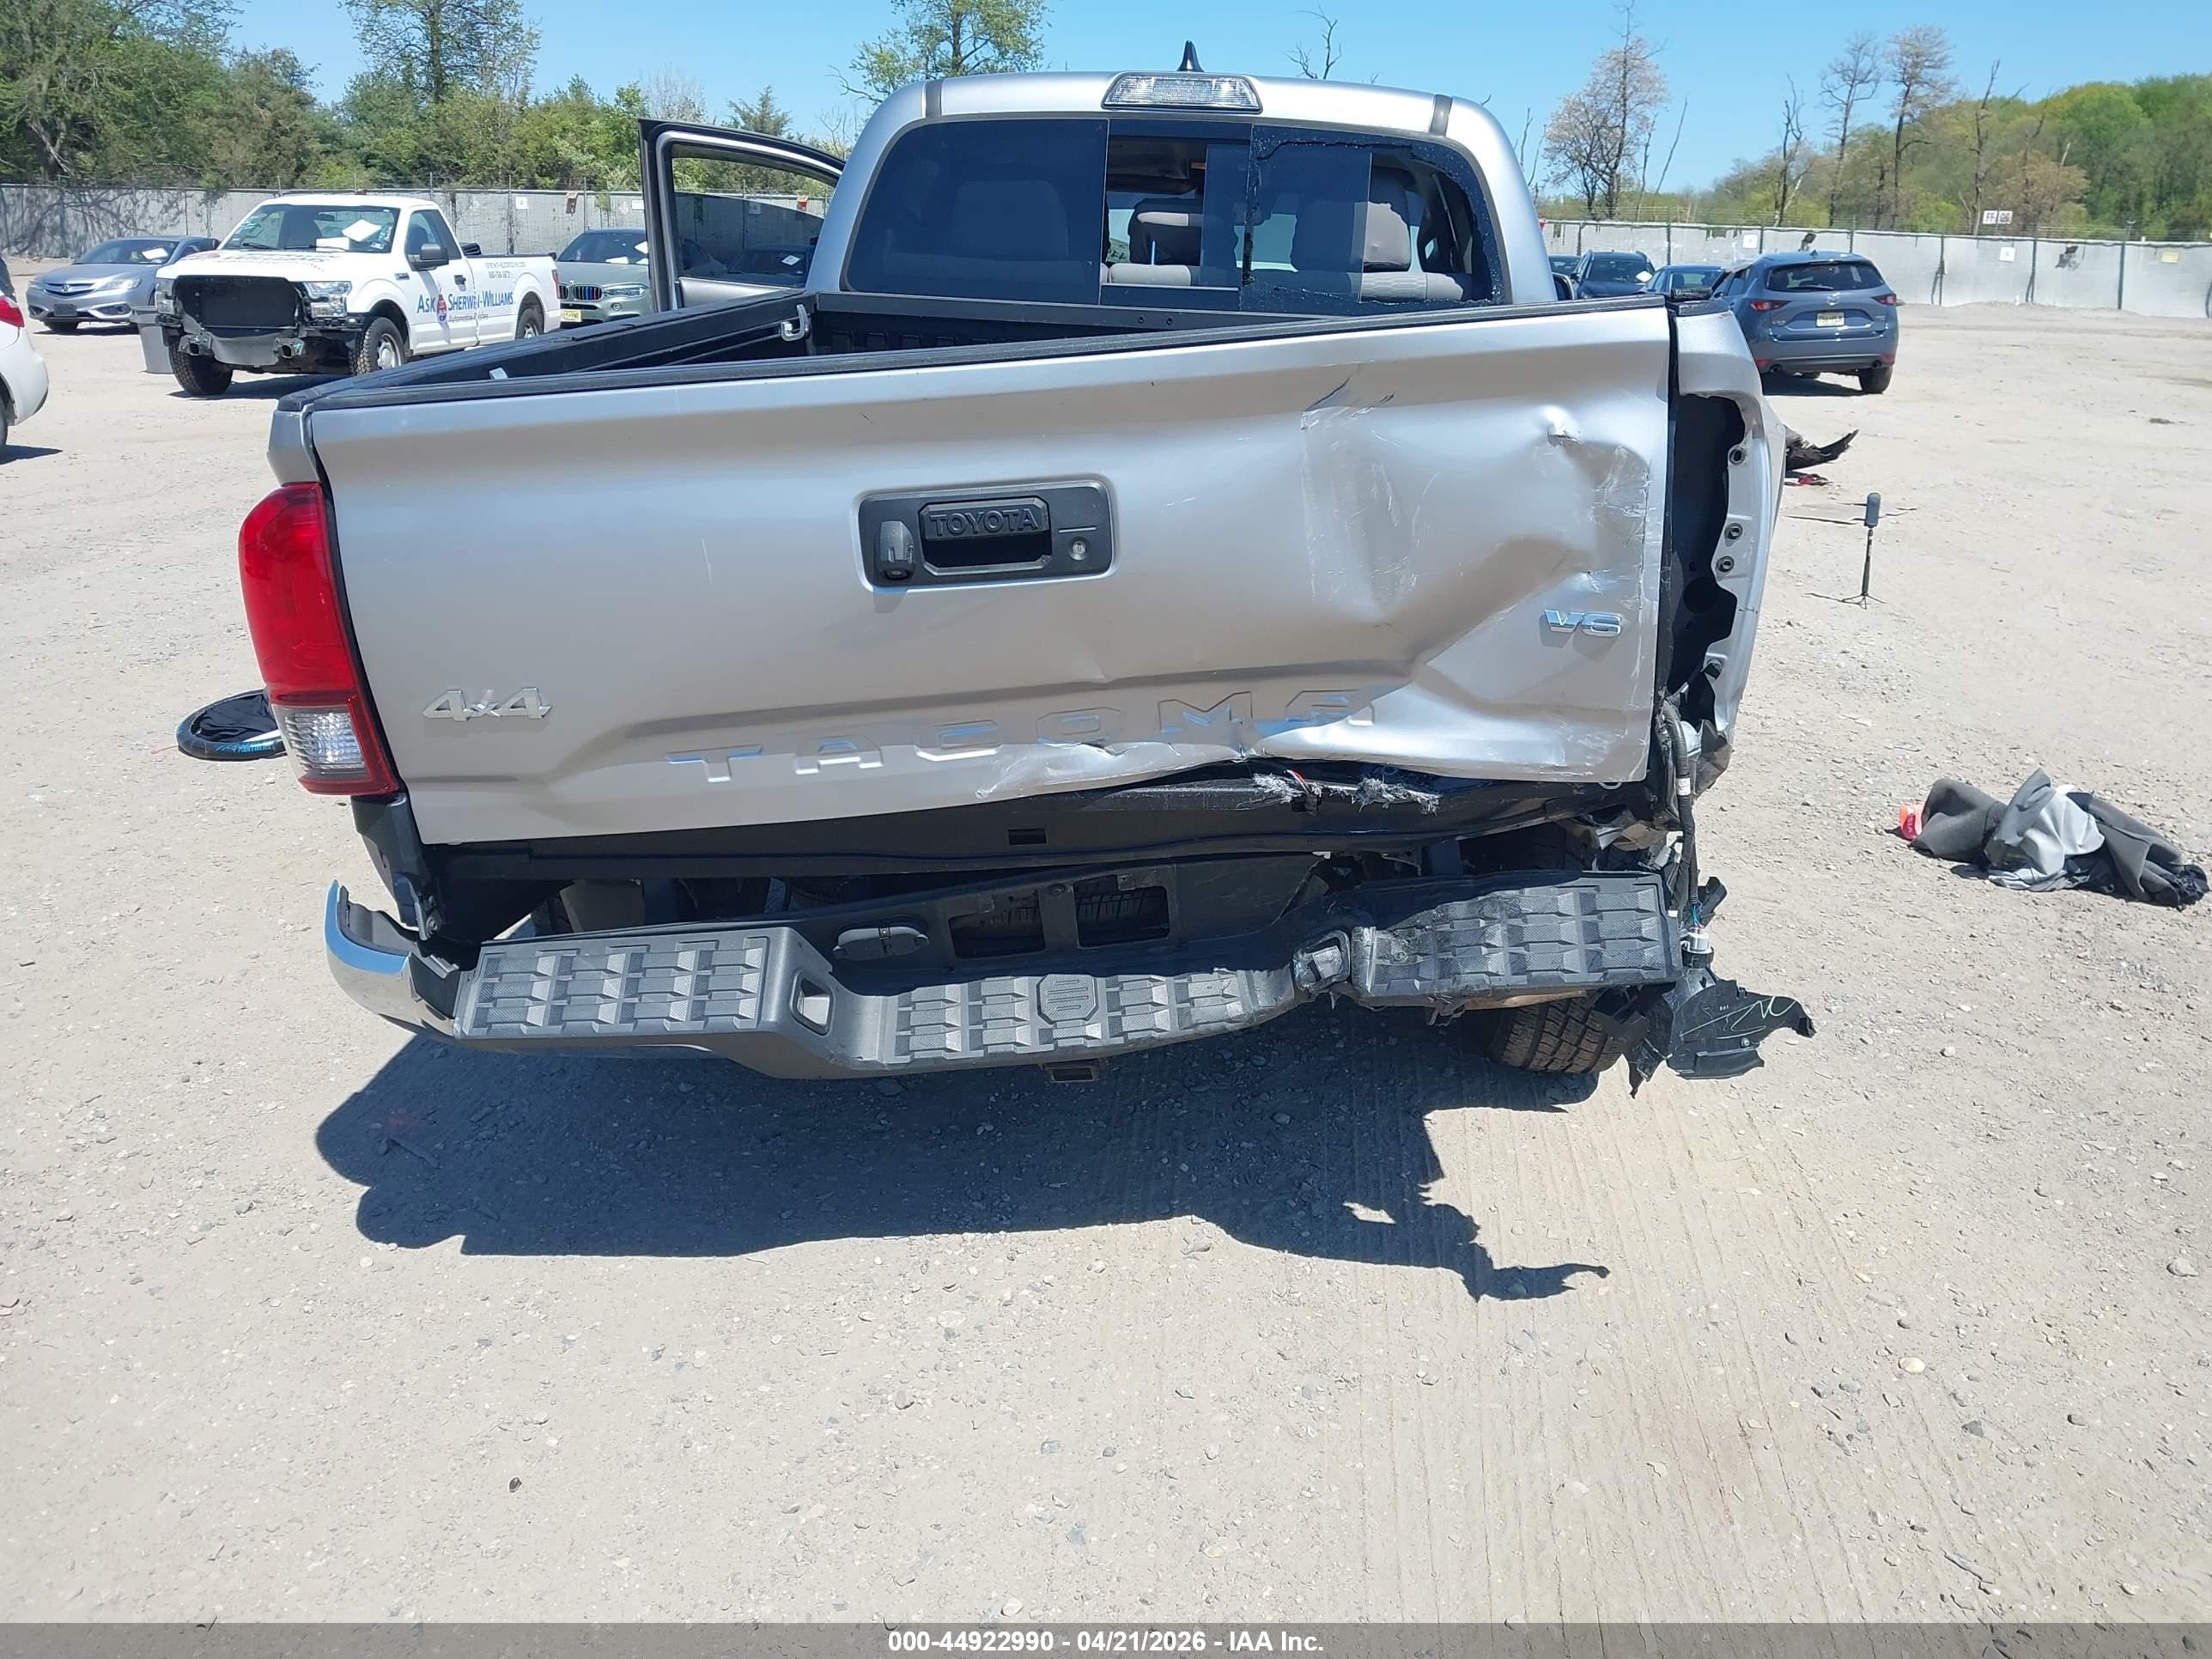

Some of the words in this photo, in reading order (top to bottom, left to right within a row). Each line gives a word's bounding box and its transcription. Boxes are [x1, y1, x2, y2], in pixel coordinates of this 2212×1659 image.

[416, 294, 436, 313] ASK
[930, 508, 1039, 537] TOYOTA
[1544, 609, 1622, 637] V6
[422, 686, 552, 722] 4x4
[665, 689, 1376, 782] TACOMA
